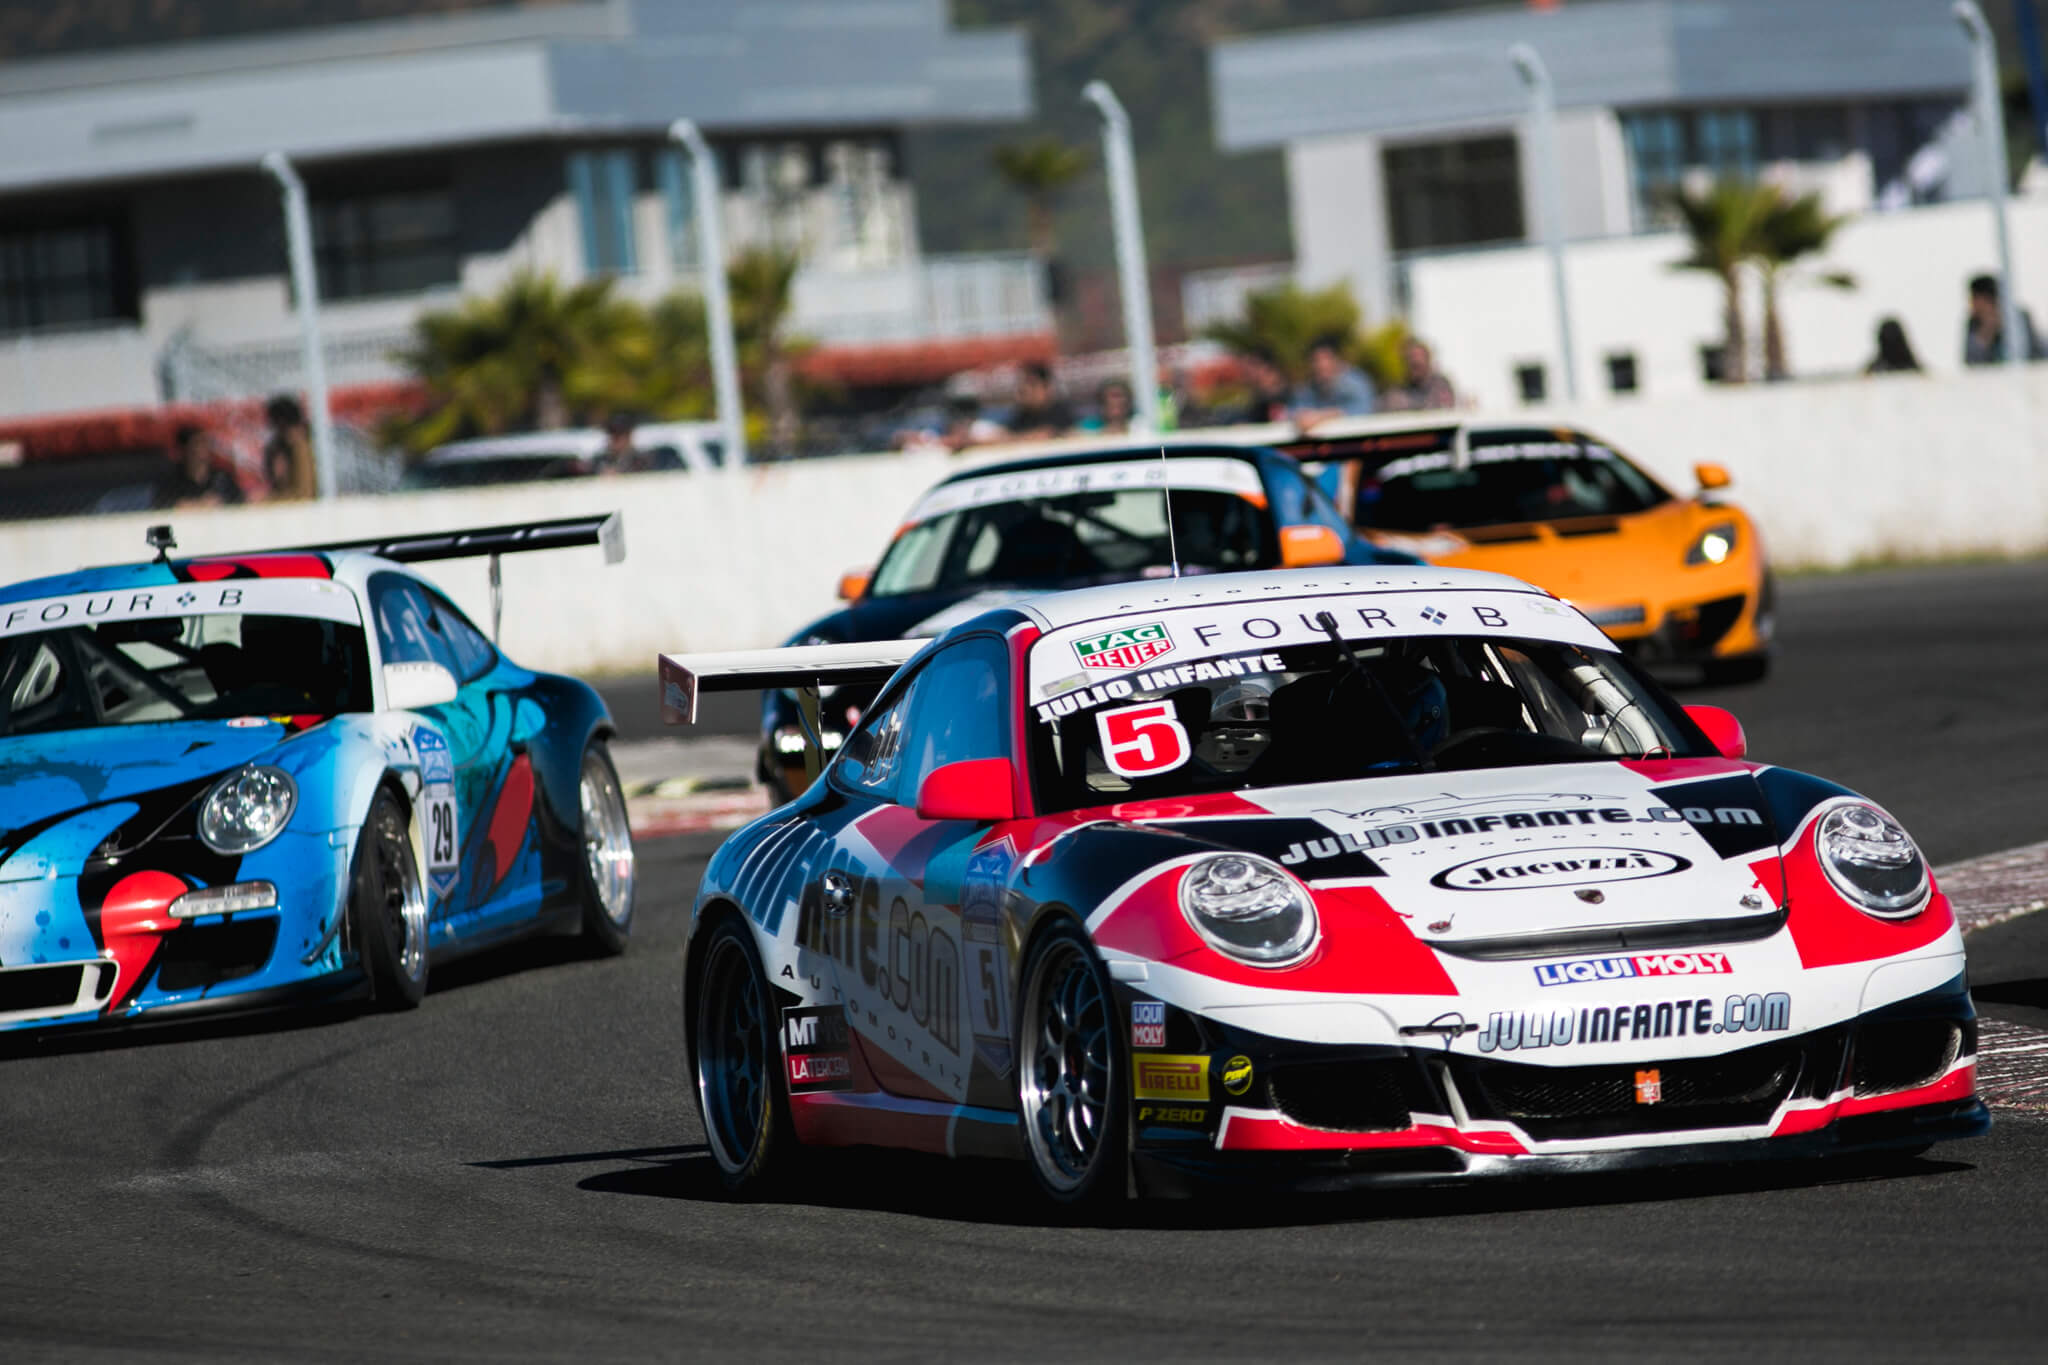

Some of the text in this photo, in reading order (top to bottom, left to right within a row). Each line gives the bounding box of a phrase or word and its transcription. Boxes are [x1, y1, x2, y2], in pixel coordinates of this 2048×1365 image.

[5, 588, 243, 629] FOUR B
[1080, 625, 1161, 652] TAG
[1193, 607, 1396, 648] FOUR
[1471, 605, 1509, 628] B
[1082, 639, 1172, 668] HEUER
[1036, 679, 1133, 724] JULIO
[1136, 653, 1287, 692] INFANTE
[1096, 699, 1191, 777] 5
[432, 802, 453, 863] 29
[1468, 853, 1655, 884] Jacuzzi
[1539, 952, 1727, 985] LIQUI MOLY
[978, 948, 999, 1032] 5
[781, 963, 963, 1089] AUTOMOTRIZ
[1132, 1004, 1162, 1023] LIQUI
[1133, 1025, 1163, 1044] MOLY
[1139, 1062, 1202, 1091] PIRELLI
[1138, 1106, 1207, 1123] P ZERO
